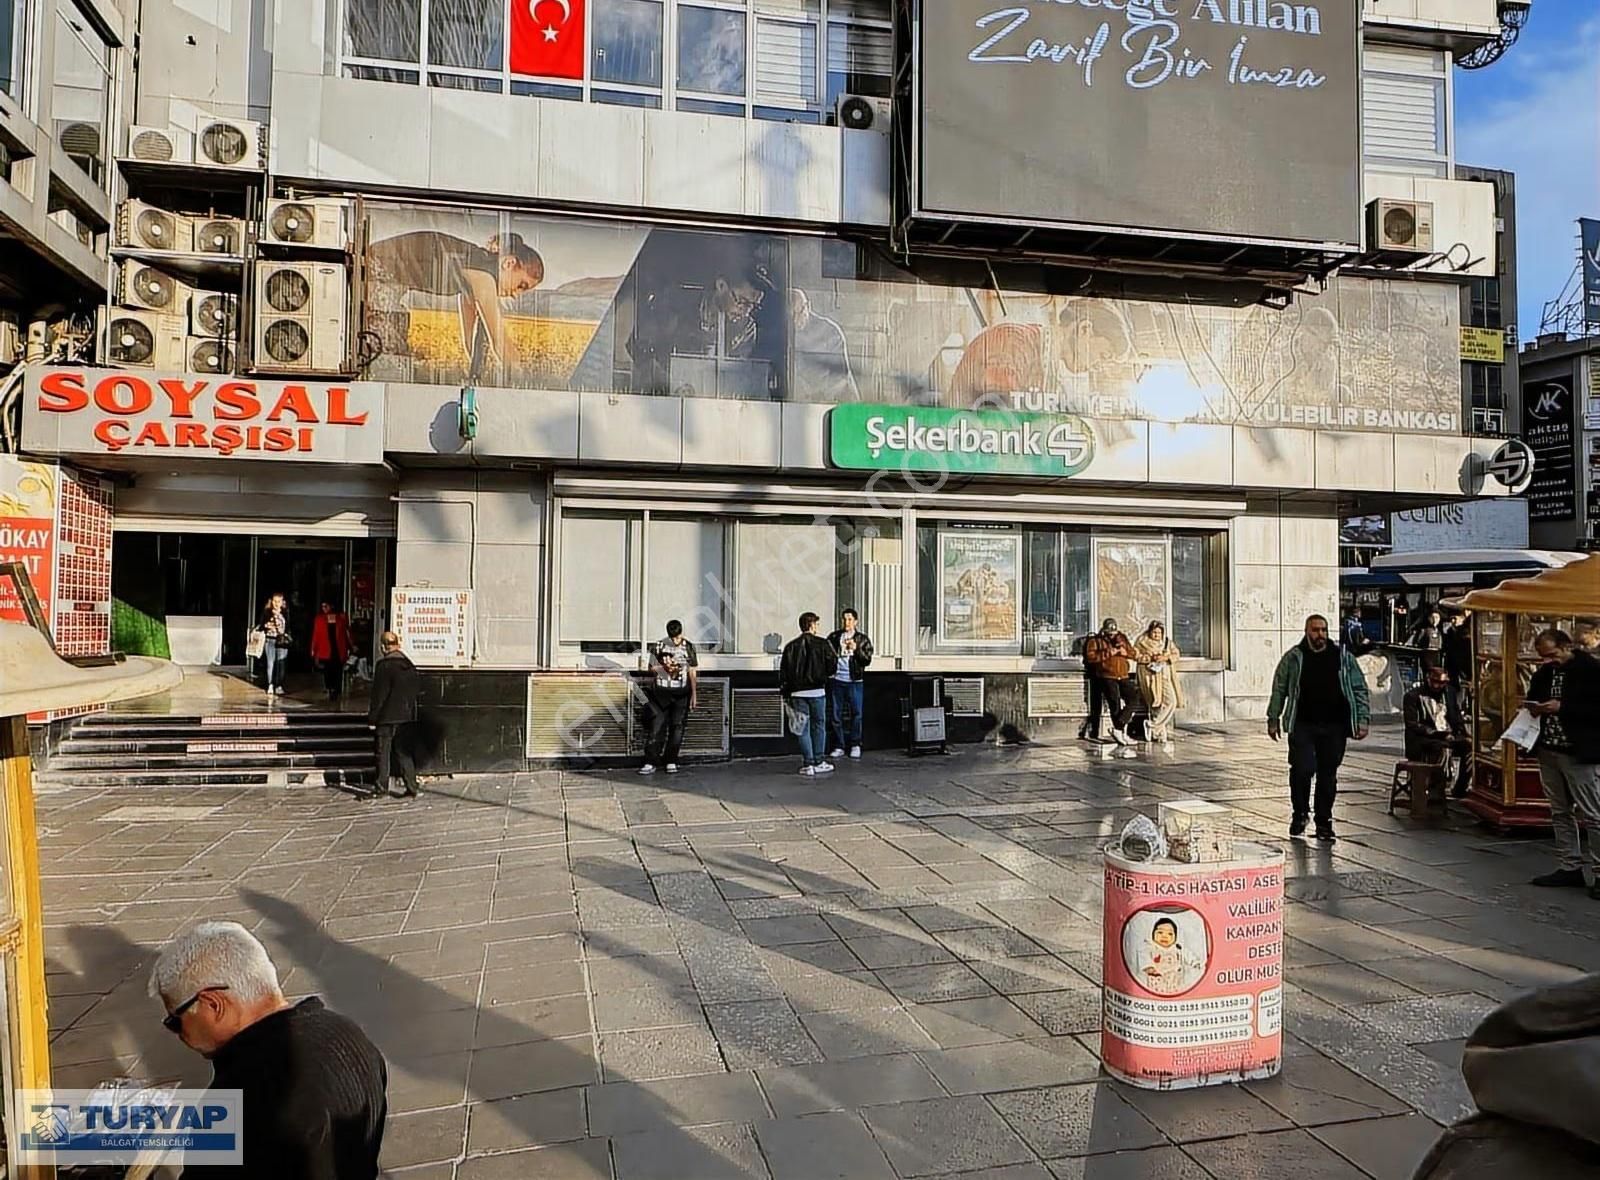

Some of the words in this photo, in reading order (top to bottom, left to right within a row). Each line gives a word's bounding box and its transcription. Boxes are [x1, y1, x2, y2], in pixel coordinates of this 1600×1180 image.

[968, 8, 1109, 86] Zarif
[1120, 18, 1213, 88] Bir
[38, 372, 370, 426] SOYSAL
[1364, 407, 1457, 431] BANKASI
[94, 419, 314, 455] ÇARŞISI
[866, 416, 1043, 459] Şekerbank
[0, 554, 43, 575] AT
[1114, 872, 1151, 894] TİP-1
[1155, 882, 1185, 895] KAS
[1190, 878, 1246, 894] HASTASI
[1228, 898, 1276, 918] VALİLİK
[1217, 967, 1252, 984] OLUR
[1133, 1002, 1154, 1012] 0001
[1133, 1017, 1154, 1027] 0001
[1133, 1033, 1154, 1043] 0001
